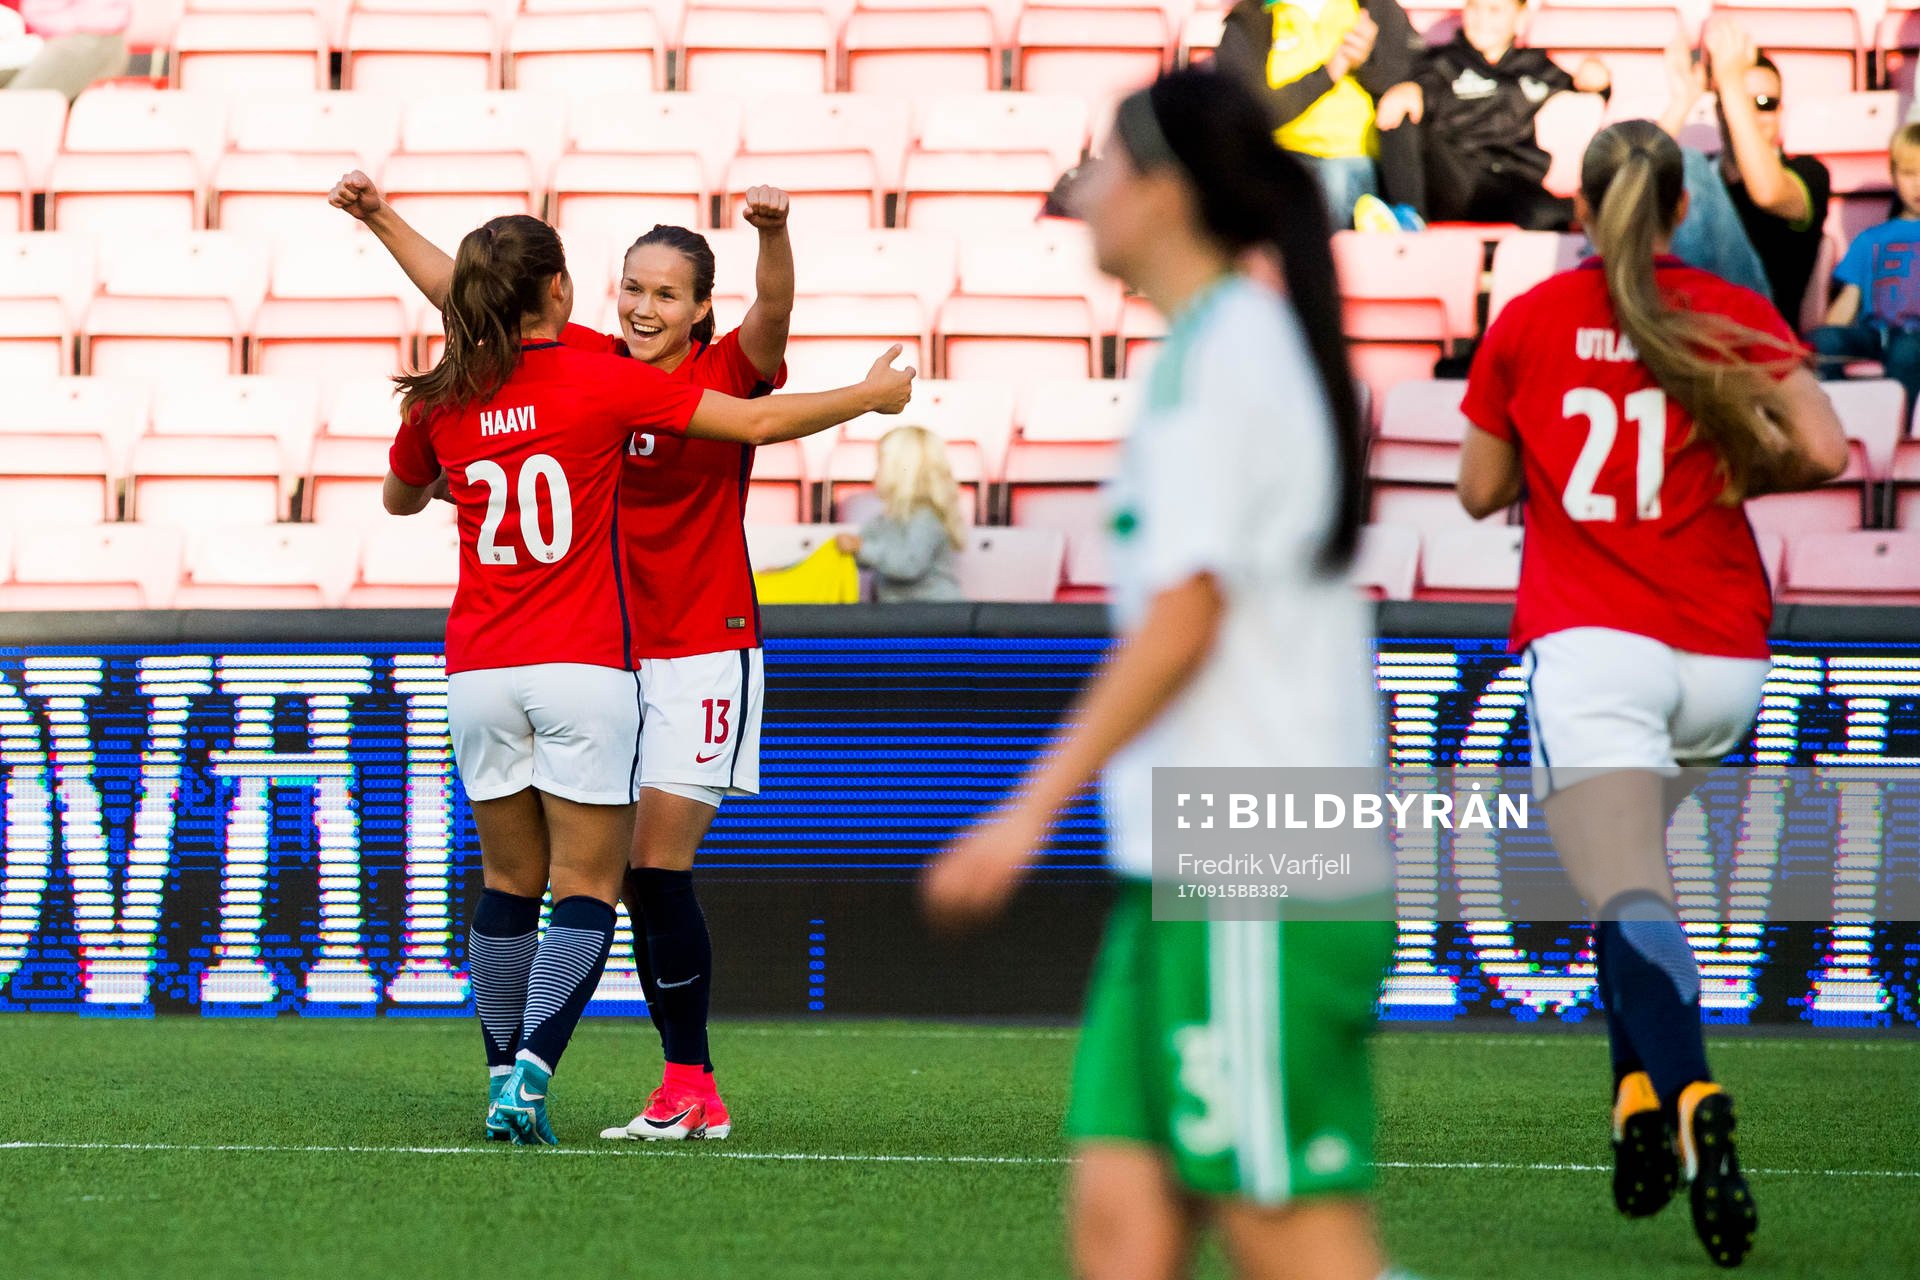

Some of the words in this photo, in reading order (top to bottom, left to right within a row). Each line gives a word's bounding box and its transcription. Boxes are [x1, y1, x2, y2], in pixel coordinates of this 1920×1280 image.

[480, 405, 536, 437] HAAVI
[1562, 387, 1666, 522] 21
[465, 453, 572, 565] 20
[702, 698, 731, 744] 13
